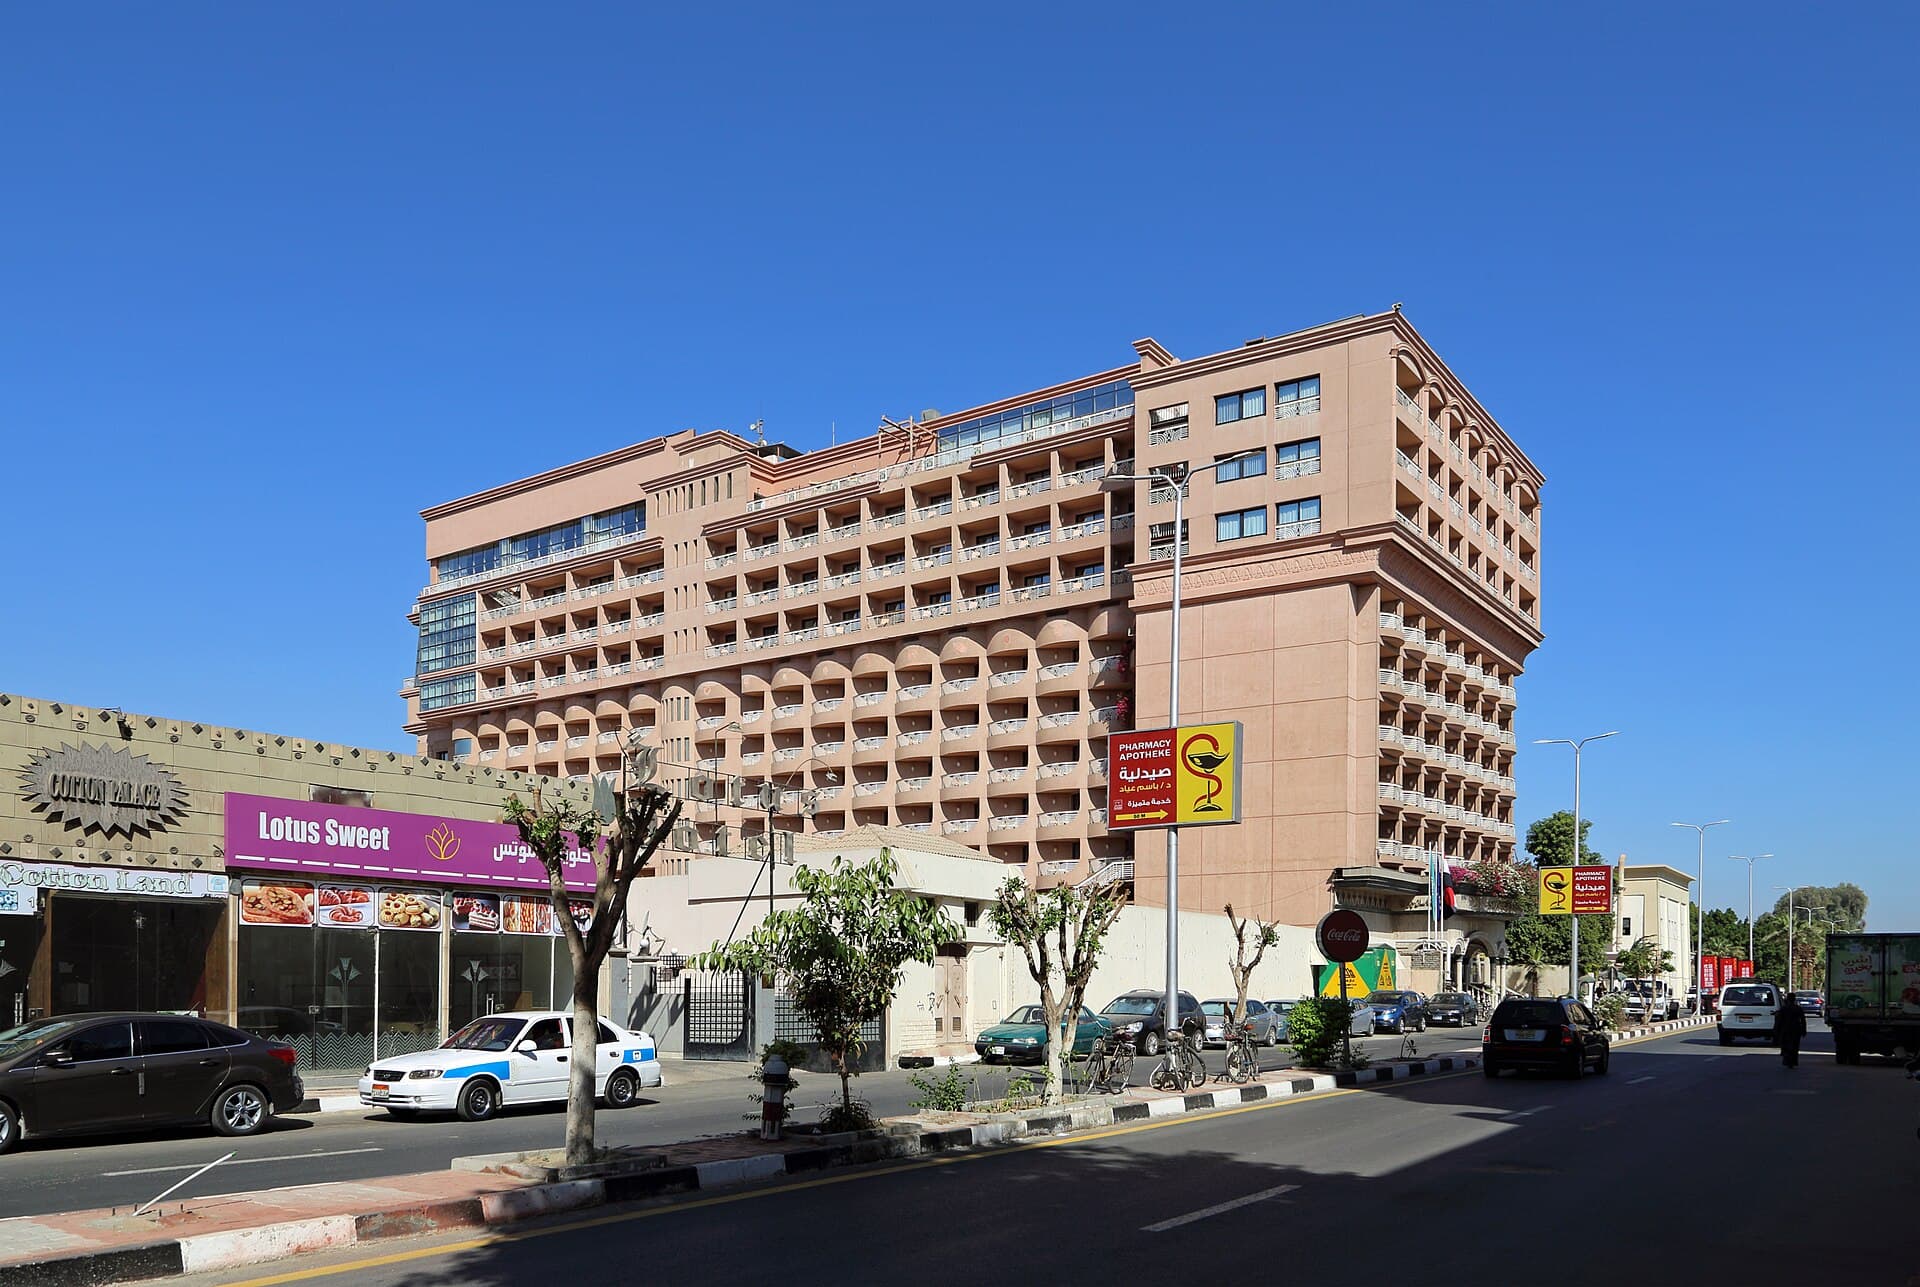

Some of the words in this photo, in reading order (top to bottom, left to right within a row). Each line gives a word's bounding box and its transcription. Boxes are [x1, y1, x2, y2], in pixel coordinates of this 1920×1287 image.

[1119, 739, 1172, 752] PHARMACY
[1119, 748, 1172, 761] APOTHEKE
[1119, 766, 1172, 782] صيدلية
[50, 773, 106, 804] COTTON
[109, 779, 161, 810] PALACE
[1136, 782, 1159, 792] باسم
[1127, 799, 1151, 809] متميزة
[1150, 797, 1172, 806] خدمة
[258, 811, 320, 843] Lotus
[325, 818, 390, 852] Sweet
[1, 862, 109, 892] Cotton
[116, 870, 193, 895] Land
[1575, 884, 1606, 892] صيدلية
[1327, 927, 1361, 942] Coca-Cola
